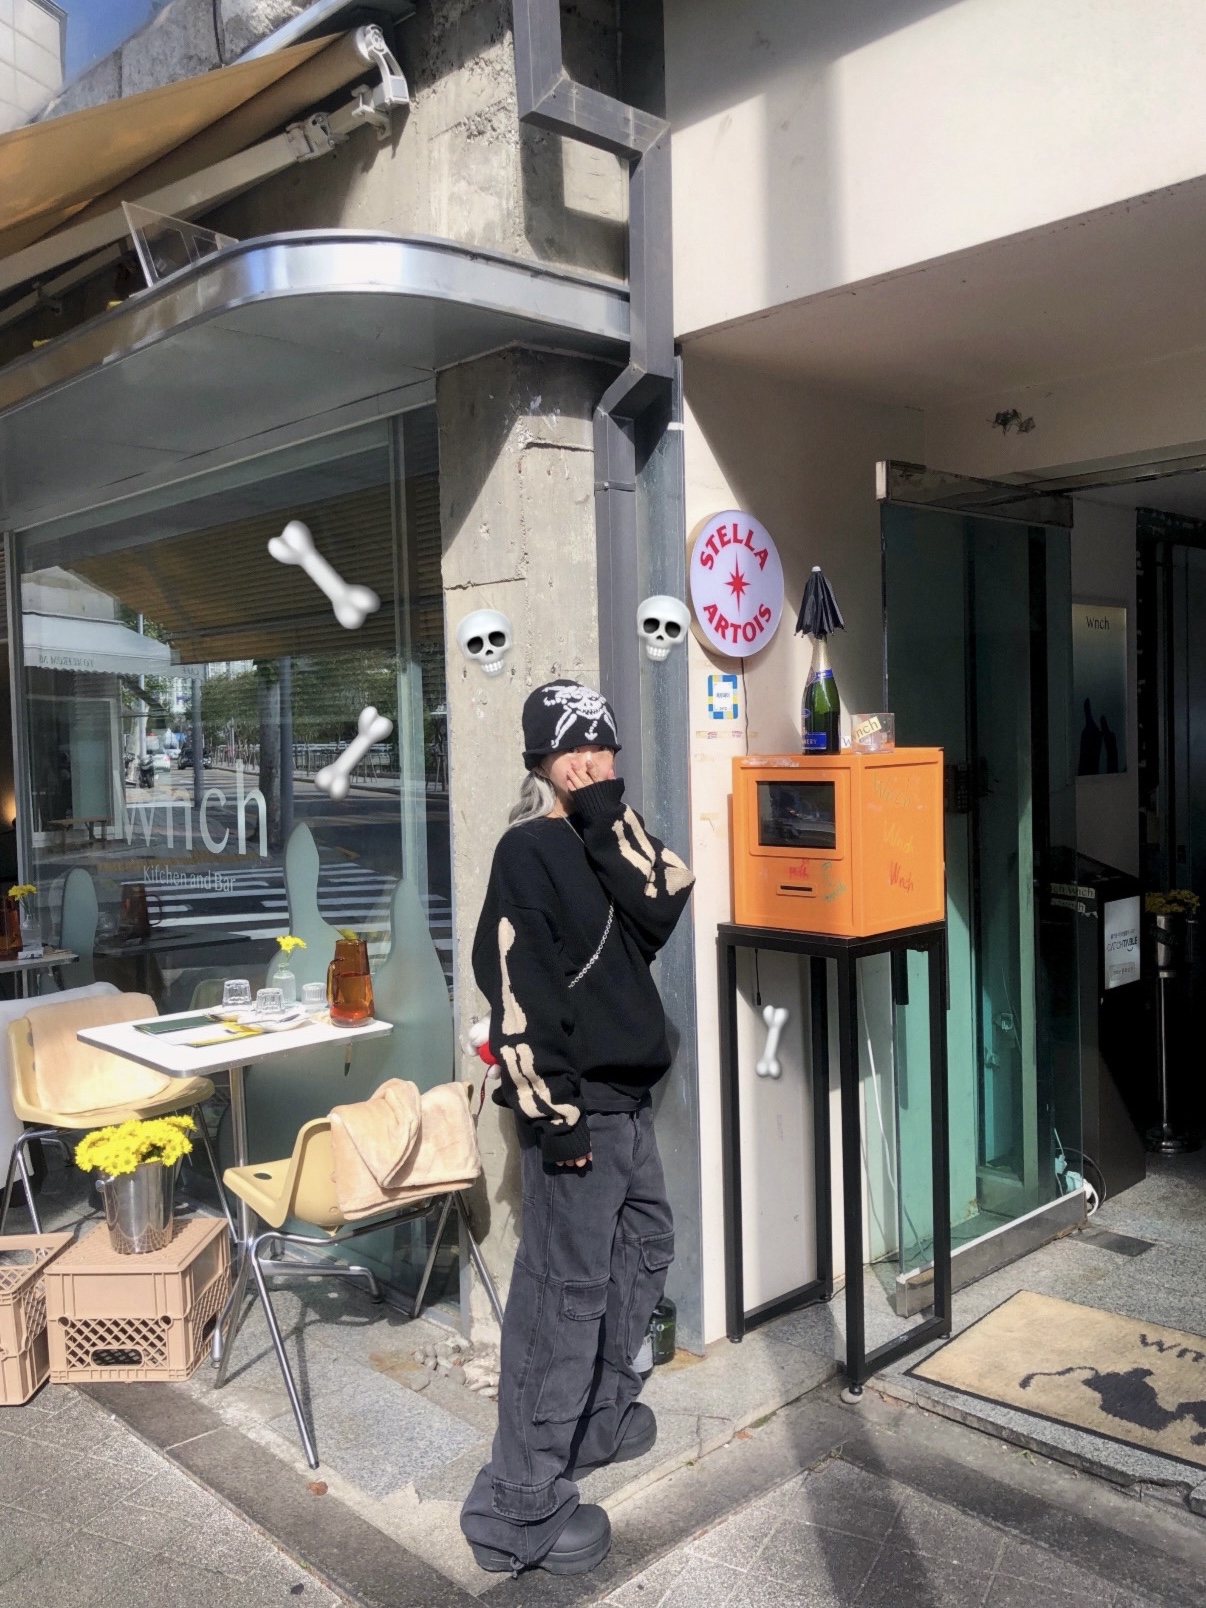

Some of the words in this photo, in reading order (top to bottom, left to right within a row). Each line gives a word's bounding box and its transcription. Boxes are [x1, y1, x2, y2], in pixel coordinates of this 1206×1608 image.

[700, 523, 769, 571] STELLA
[703, 603, 772, 643] ARTOIS
[1085, 615, 1110, 631] Wnch
[143, 864, 189, 886] Kitchen
[190, 869, 212, 890] and
[214, 872, 236, 893] Bar
